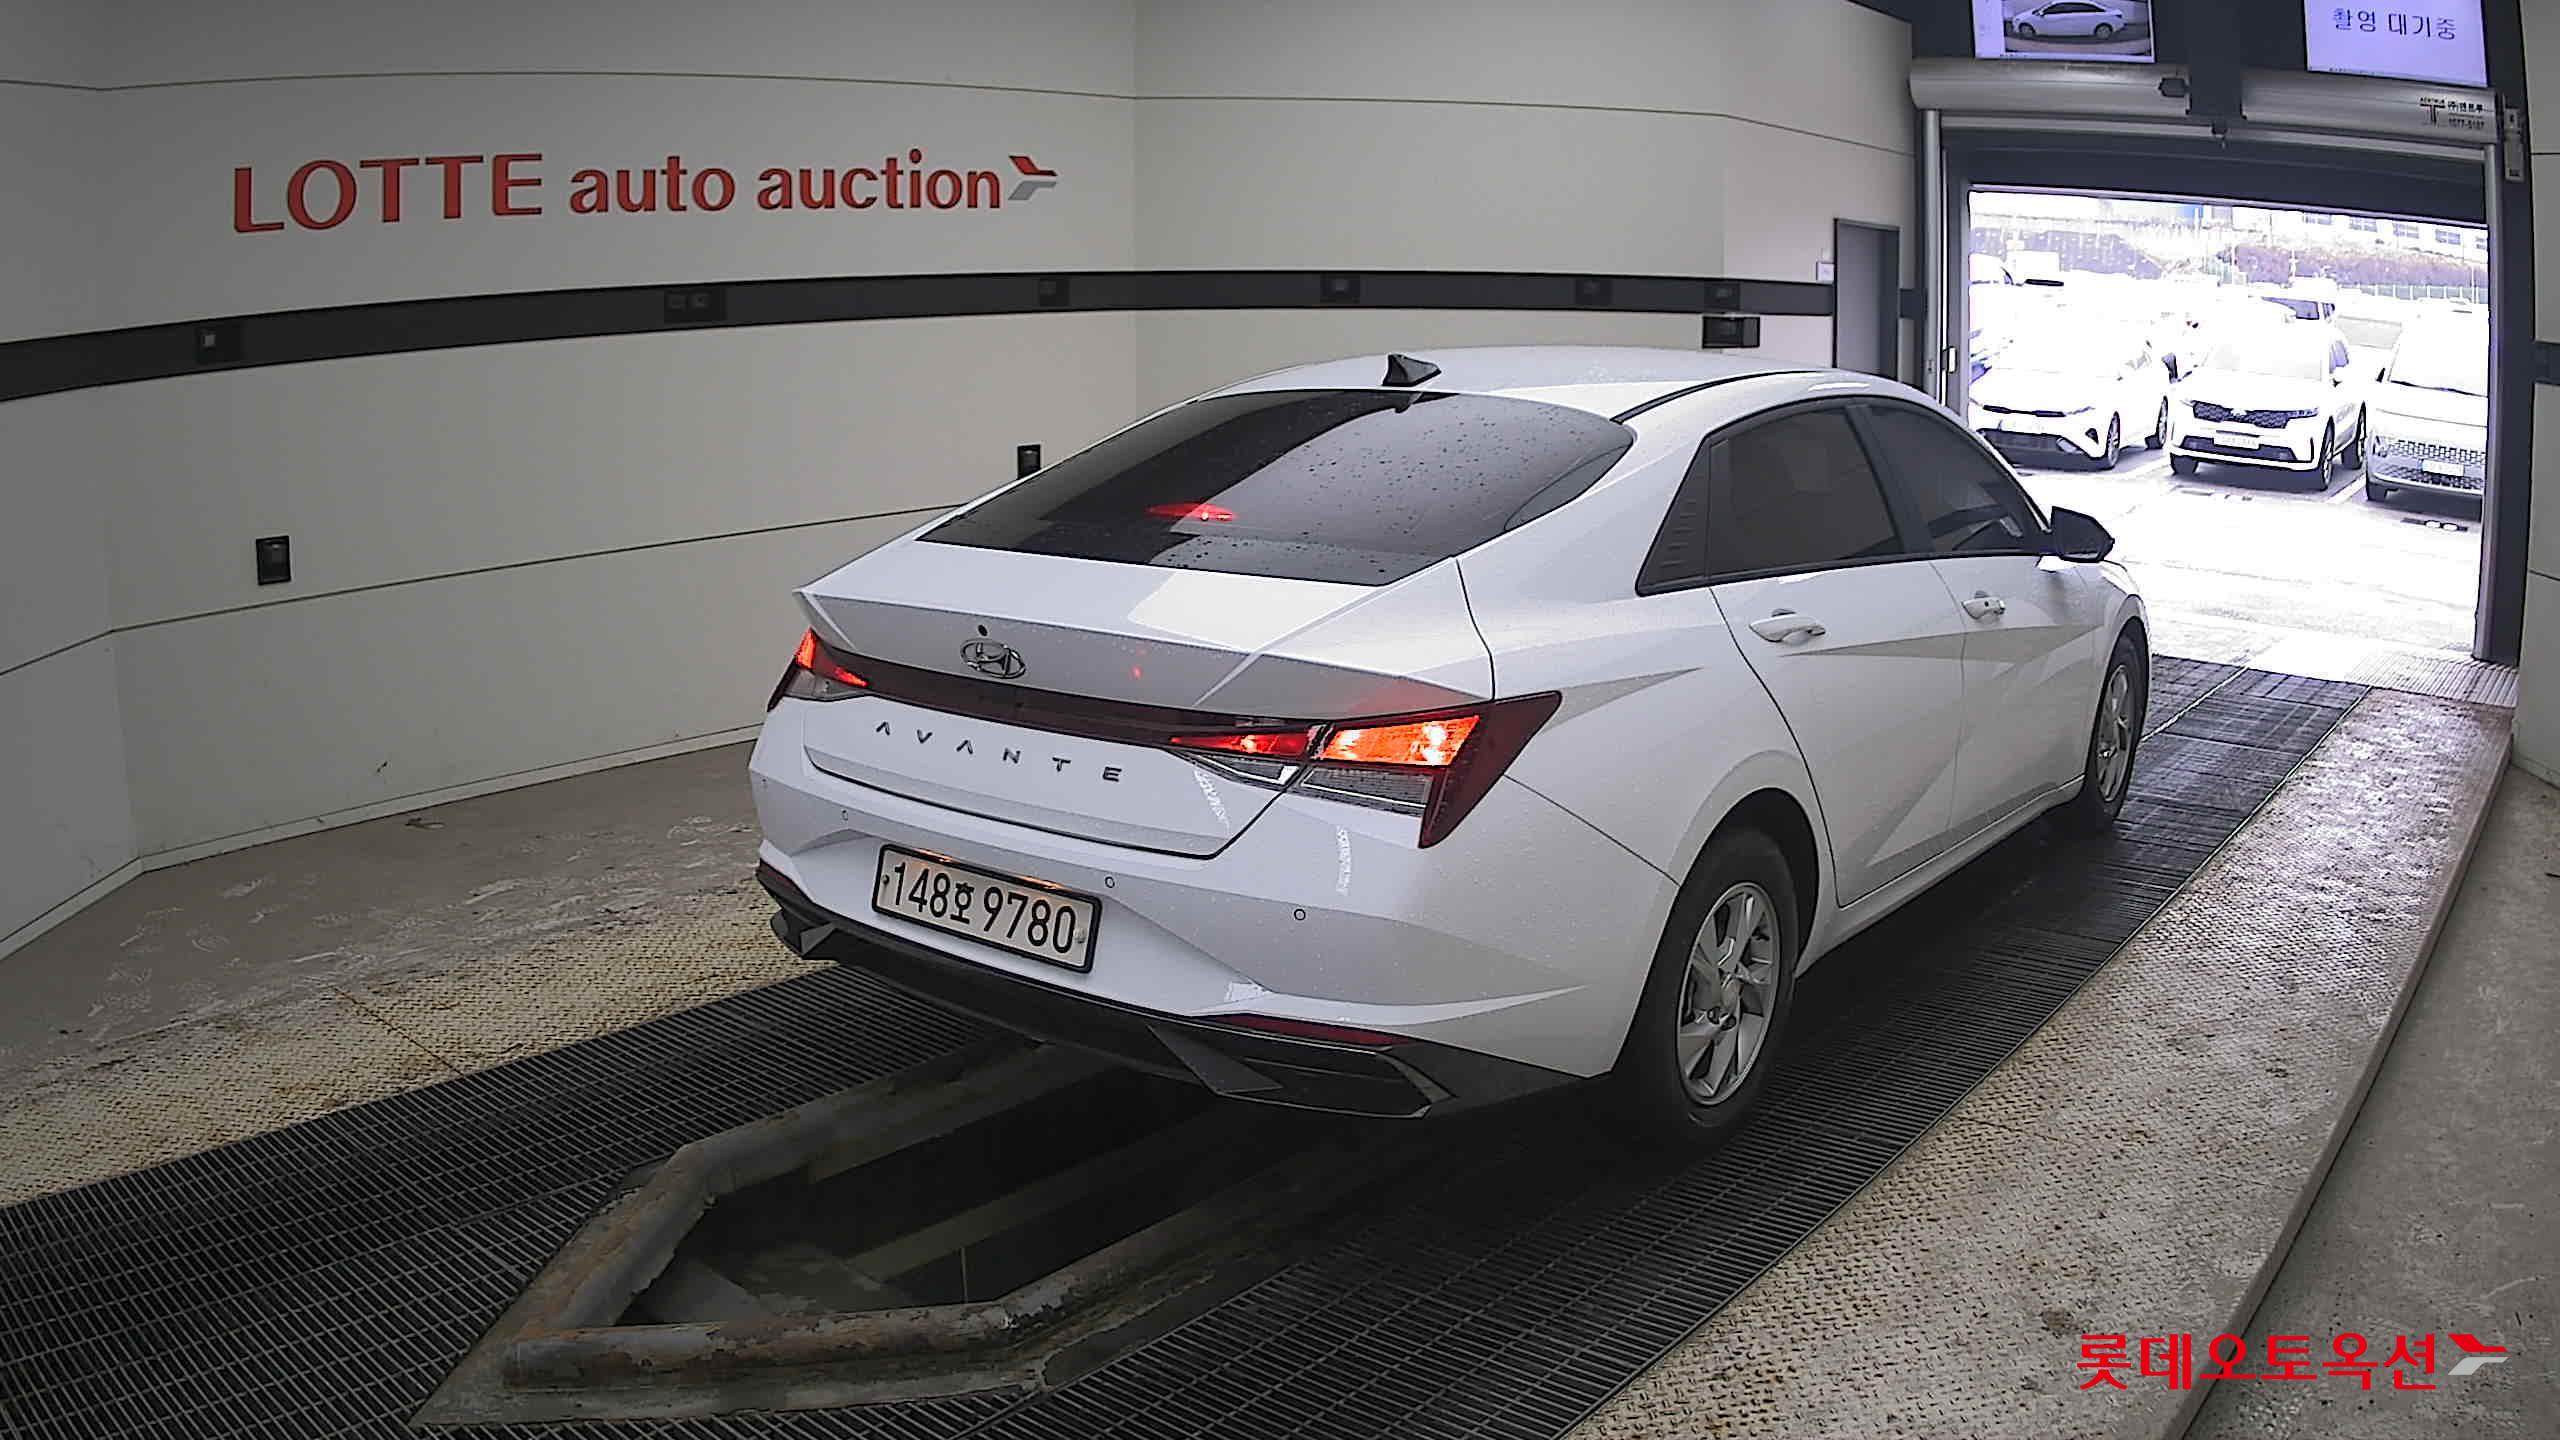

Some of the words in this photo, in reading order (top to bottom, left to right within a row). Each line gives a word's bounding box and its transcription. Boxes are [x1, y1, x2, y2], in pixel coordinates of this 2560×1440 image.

[2333, 8, 2377, 33] 촬영
[2387, 13, 2457, 40] 대기중
[233, 153, 543, 233] LOTTE
[569, 155, 736, 213] auto
[756, 149, 1002, 210] auction
[874, 720, 1123, 784] AVANTE
[982, 886, 1077, 954] 9780
